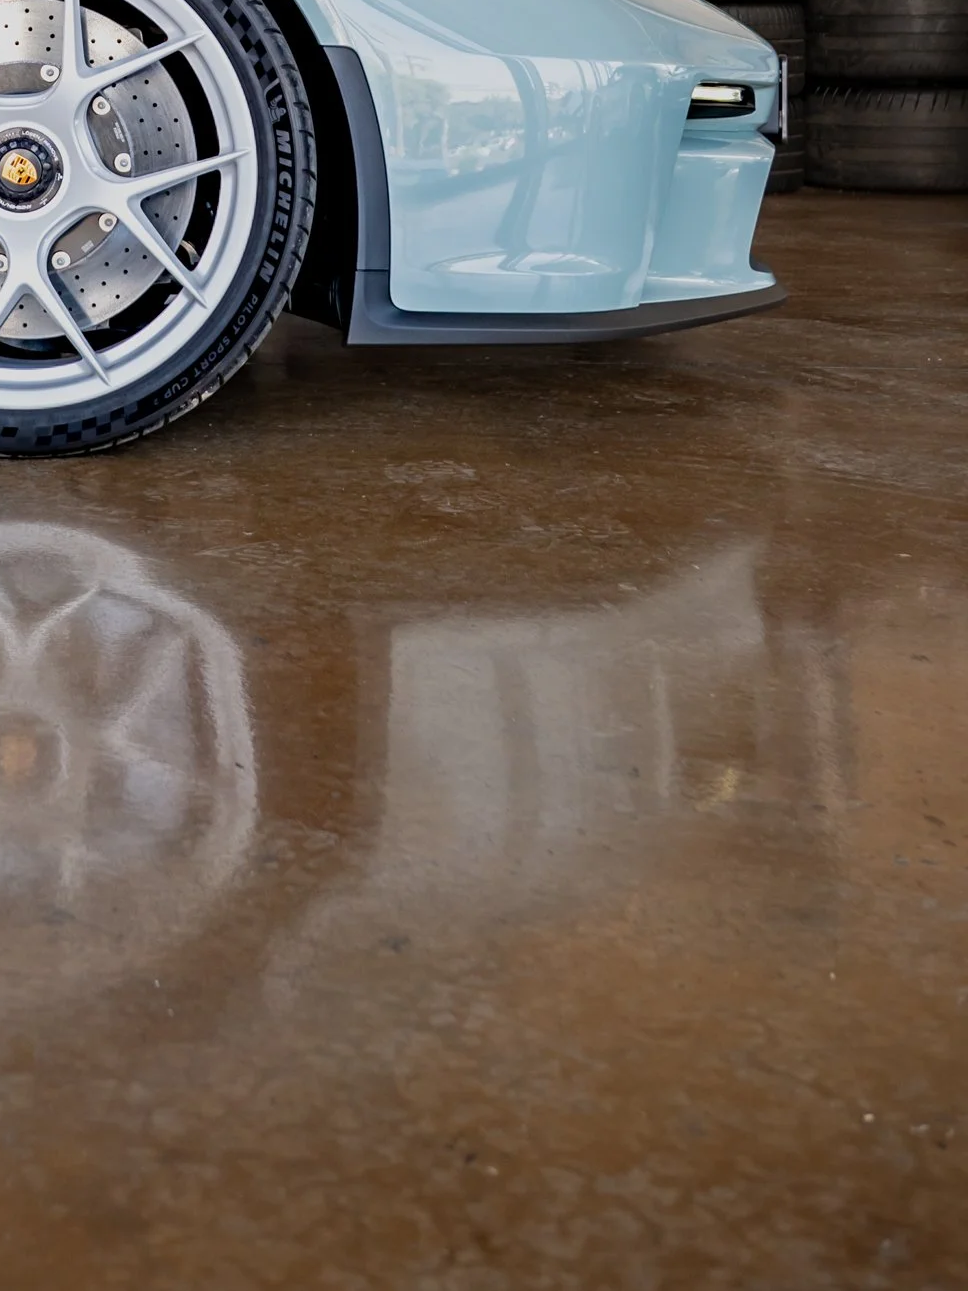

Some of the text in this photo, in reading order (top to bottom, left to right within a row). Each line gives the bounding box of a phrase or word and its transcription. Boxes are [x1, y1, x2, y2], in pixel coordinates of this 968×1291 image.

[259, 129, 292, 284] MICHELIN
[233, 294, 259, 335] PILOT
[194, 335, 231, 378] SPORT
[164, 377, 189, 399] CUP
